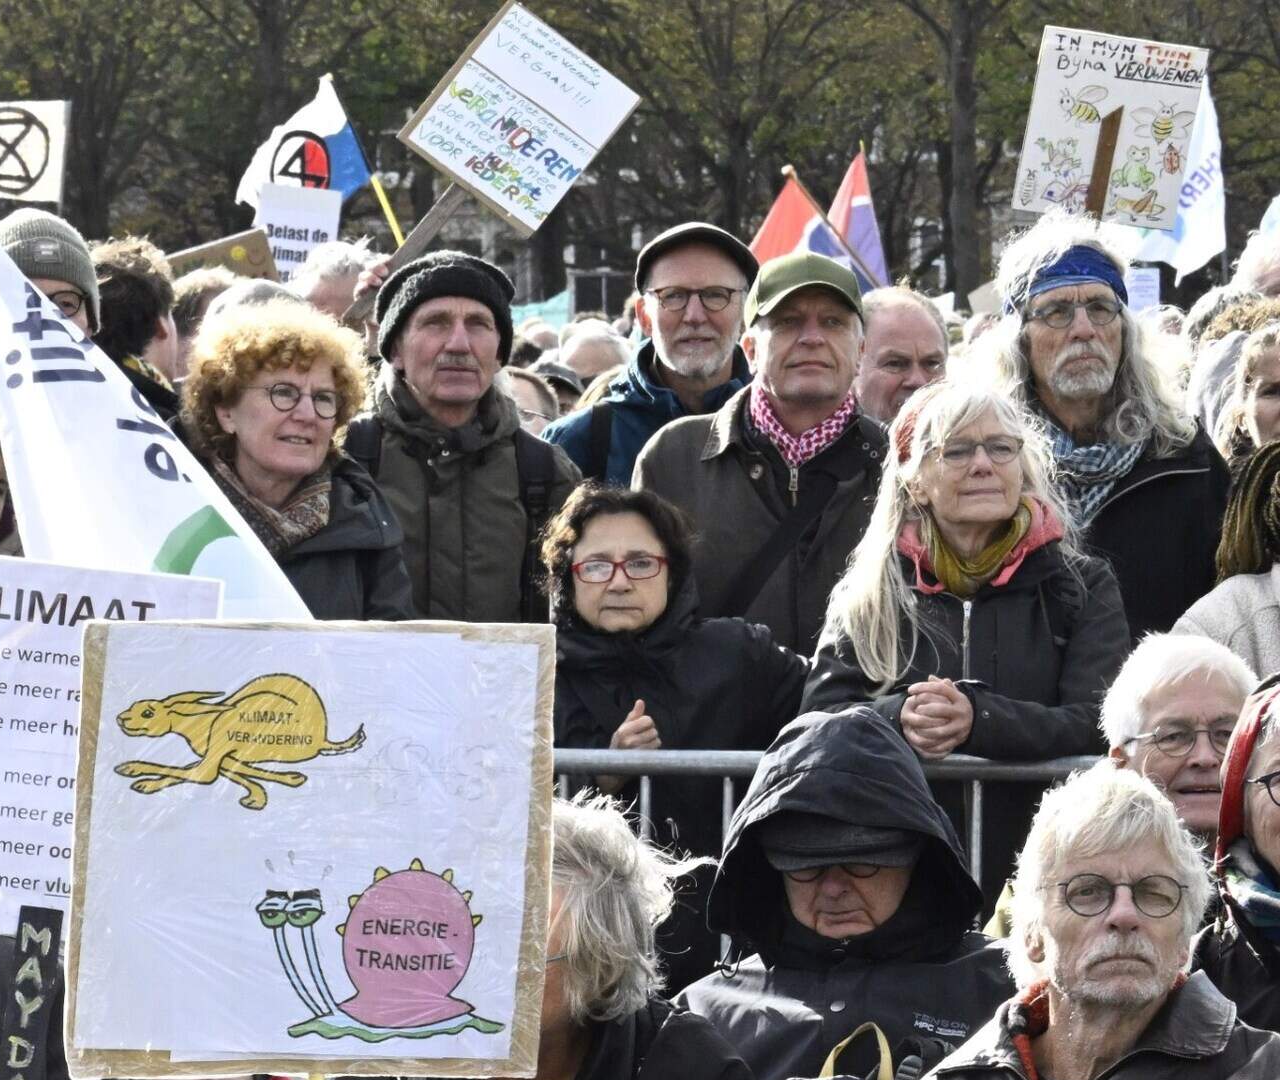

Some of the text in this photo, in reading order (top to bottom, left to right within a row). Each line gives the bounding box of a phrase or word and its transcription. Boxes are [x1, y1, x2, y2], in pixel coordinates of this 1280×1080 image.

[1056, 34, 1081, 51] IN
[1144, 45, 1192, 68] TUIN
[436, 103, 464, 123] doe
[419, 124, 464, 160] VOOR
[312, 229, 328, 243] de
[18, 646, 80, 667] warme
[13, 682, 61, 700] meer
[9, 716, 58, 734] meer
[4, 768, 52, 786] meer
[0, 803, 48, 821] meer
[355, 947, 456, 971] TRANSITIE
